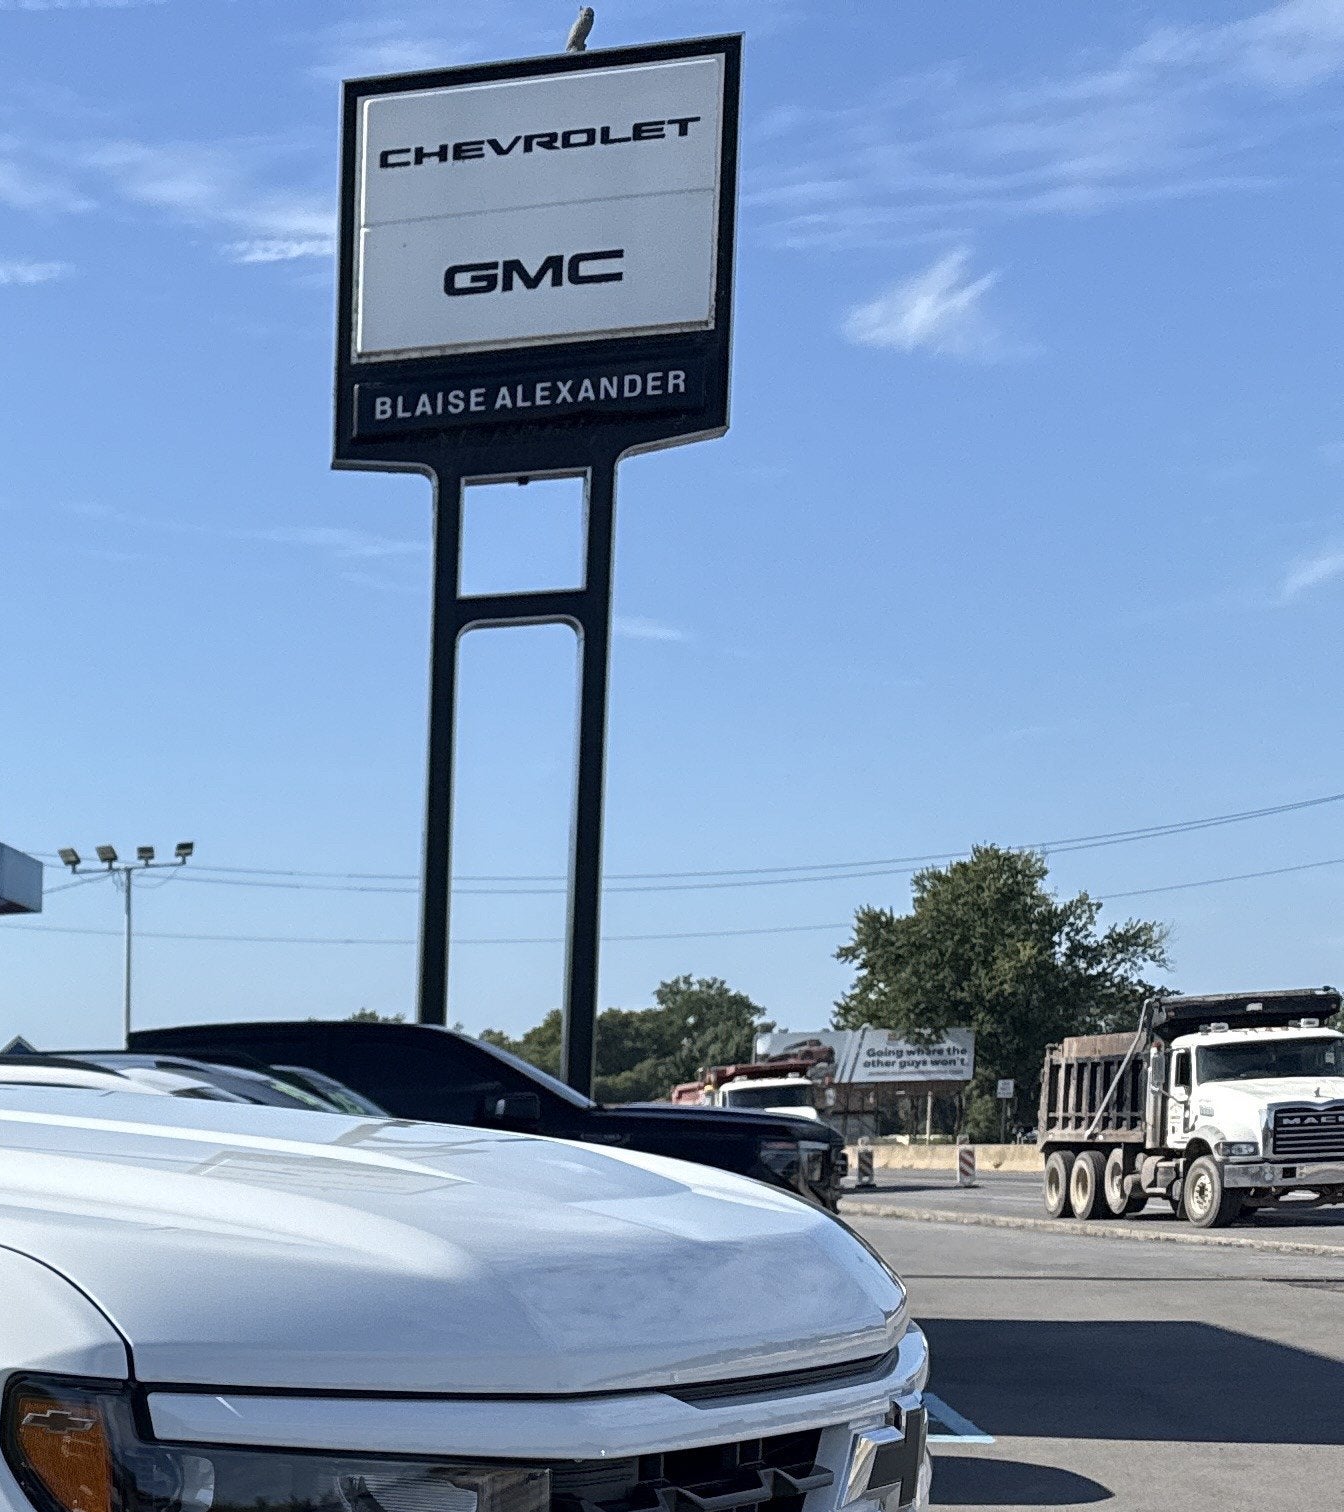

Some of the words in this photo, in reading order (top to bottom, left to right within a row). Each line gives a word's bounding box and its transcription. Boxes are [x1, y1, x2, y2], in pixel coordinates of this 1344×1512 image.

[378, 116, 702, 169] CHEVROLET
[443, 249, 625, 297] GMC
[374, 388, 487, 421] BLAISE
[493, 370, 687, 411] ALEXANDER
[863, 1059, 896, 1068] other
[898, 1059, 928, 1069] guys
[866, 1047, 903, 1059] Going
[906, 1046, 944, 1056] where
[946, 1045, 968, 1056] the
